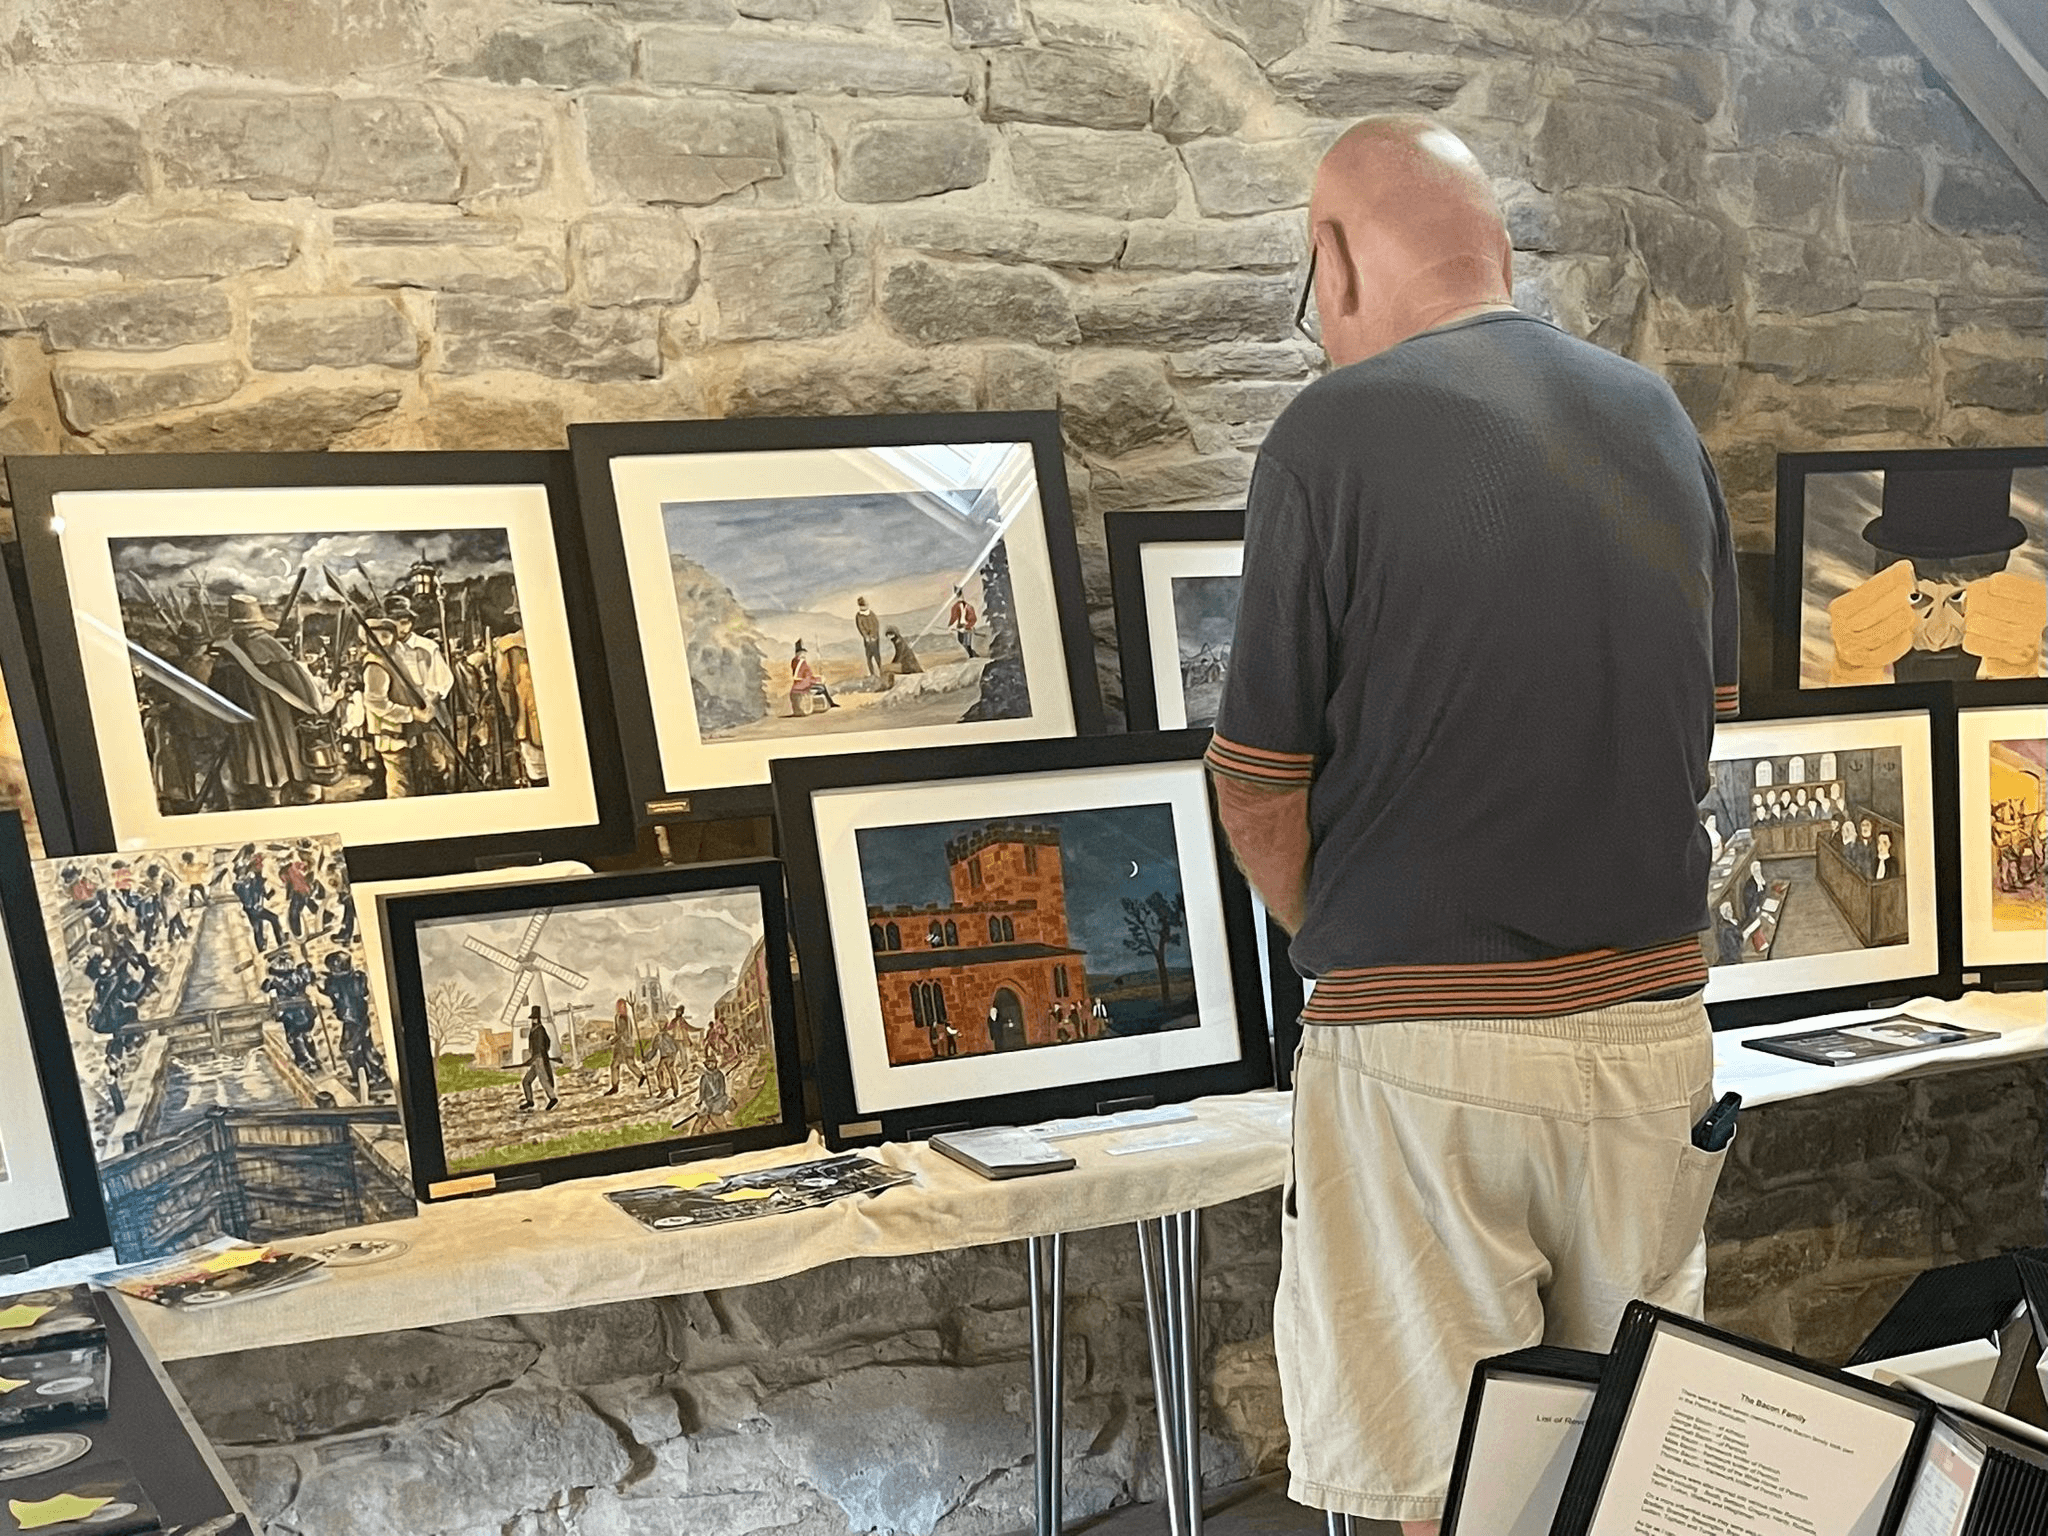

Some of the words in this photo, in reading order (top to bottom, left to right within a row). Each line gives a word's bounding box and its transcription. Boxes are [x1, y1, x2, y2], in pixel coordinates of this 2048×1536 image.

[1741, 1392, 1755, 1405] The
[1756, 1399, 1780, 1414] Bacon
[1781, 1408, 1806, 1424] Family
[1536, 1414, 1552, 1423] List
[1553, 1416, 1564, 1424] of
